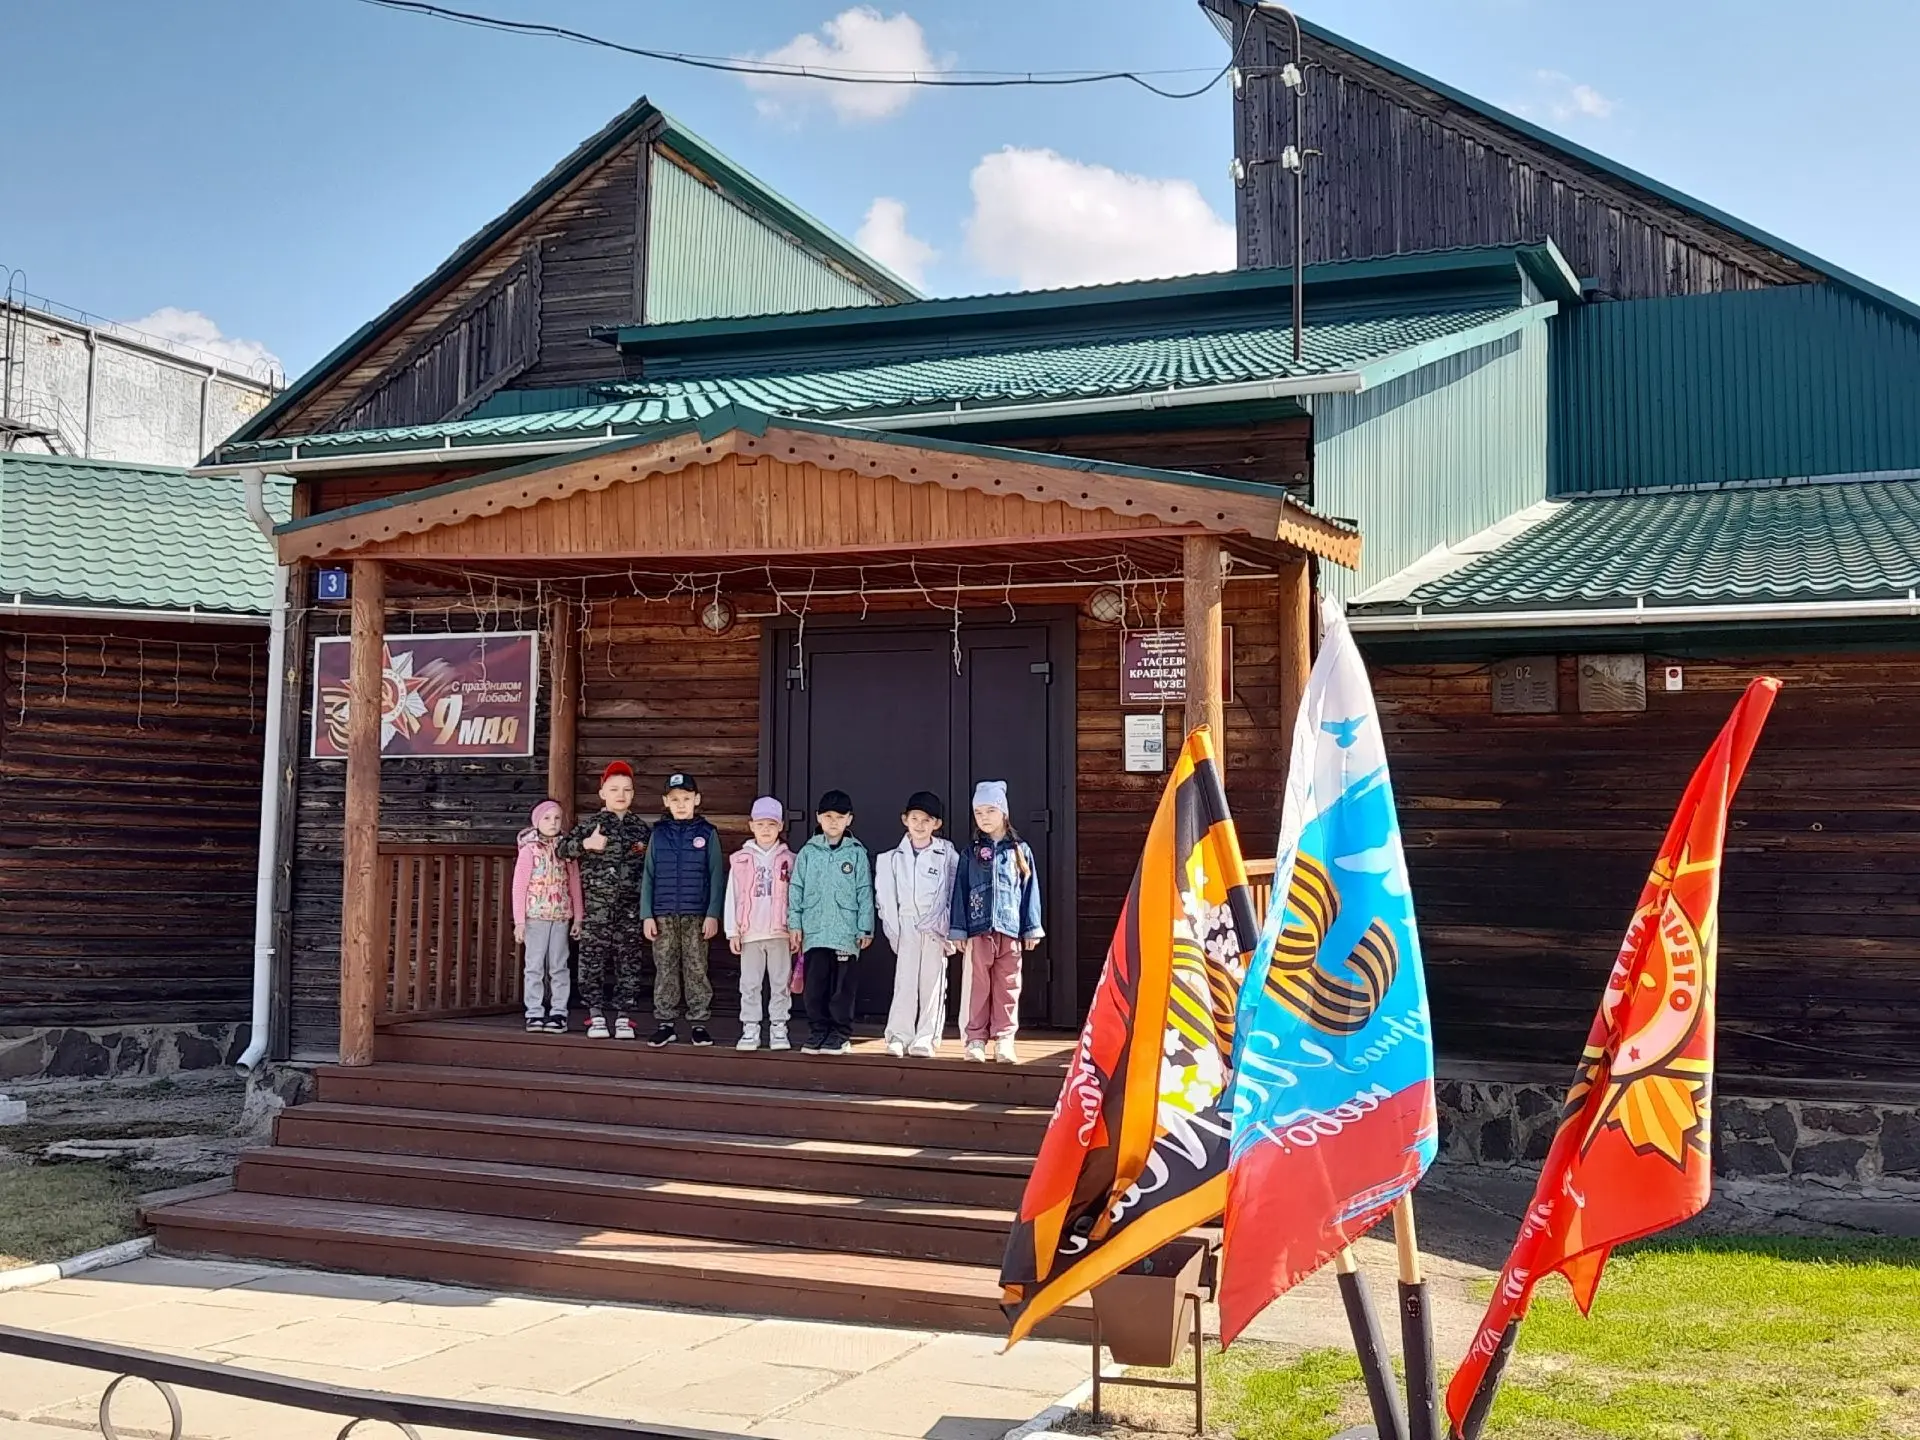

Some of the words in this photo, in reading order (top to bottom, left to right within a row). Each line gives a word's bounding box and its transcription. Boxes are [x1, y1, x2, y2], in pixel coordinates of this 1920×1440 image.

[328, 574, 338, 593] 3
[1515, 665, 1532, 679] 02
[451, 681, 460, 692] С
[461, 679, 522, 694] праздником
[477, 691, 522, 703] Победы!
[433, 694, 463, 745] 9
[457, 715, 520, 745] МАЯ
